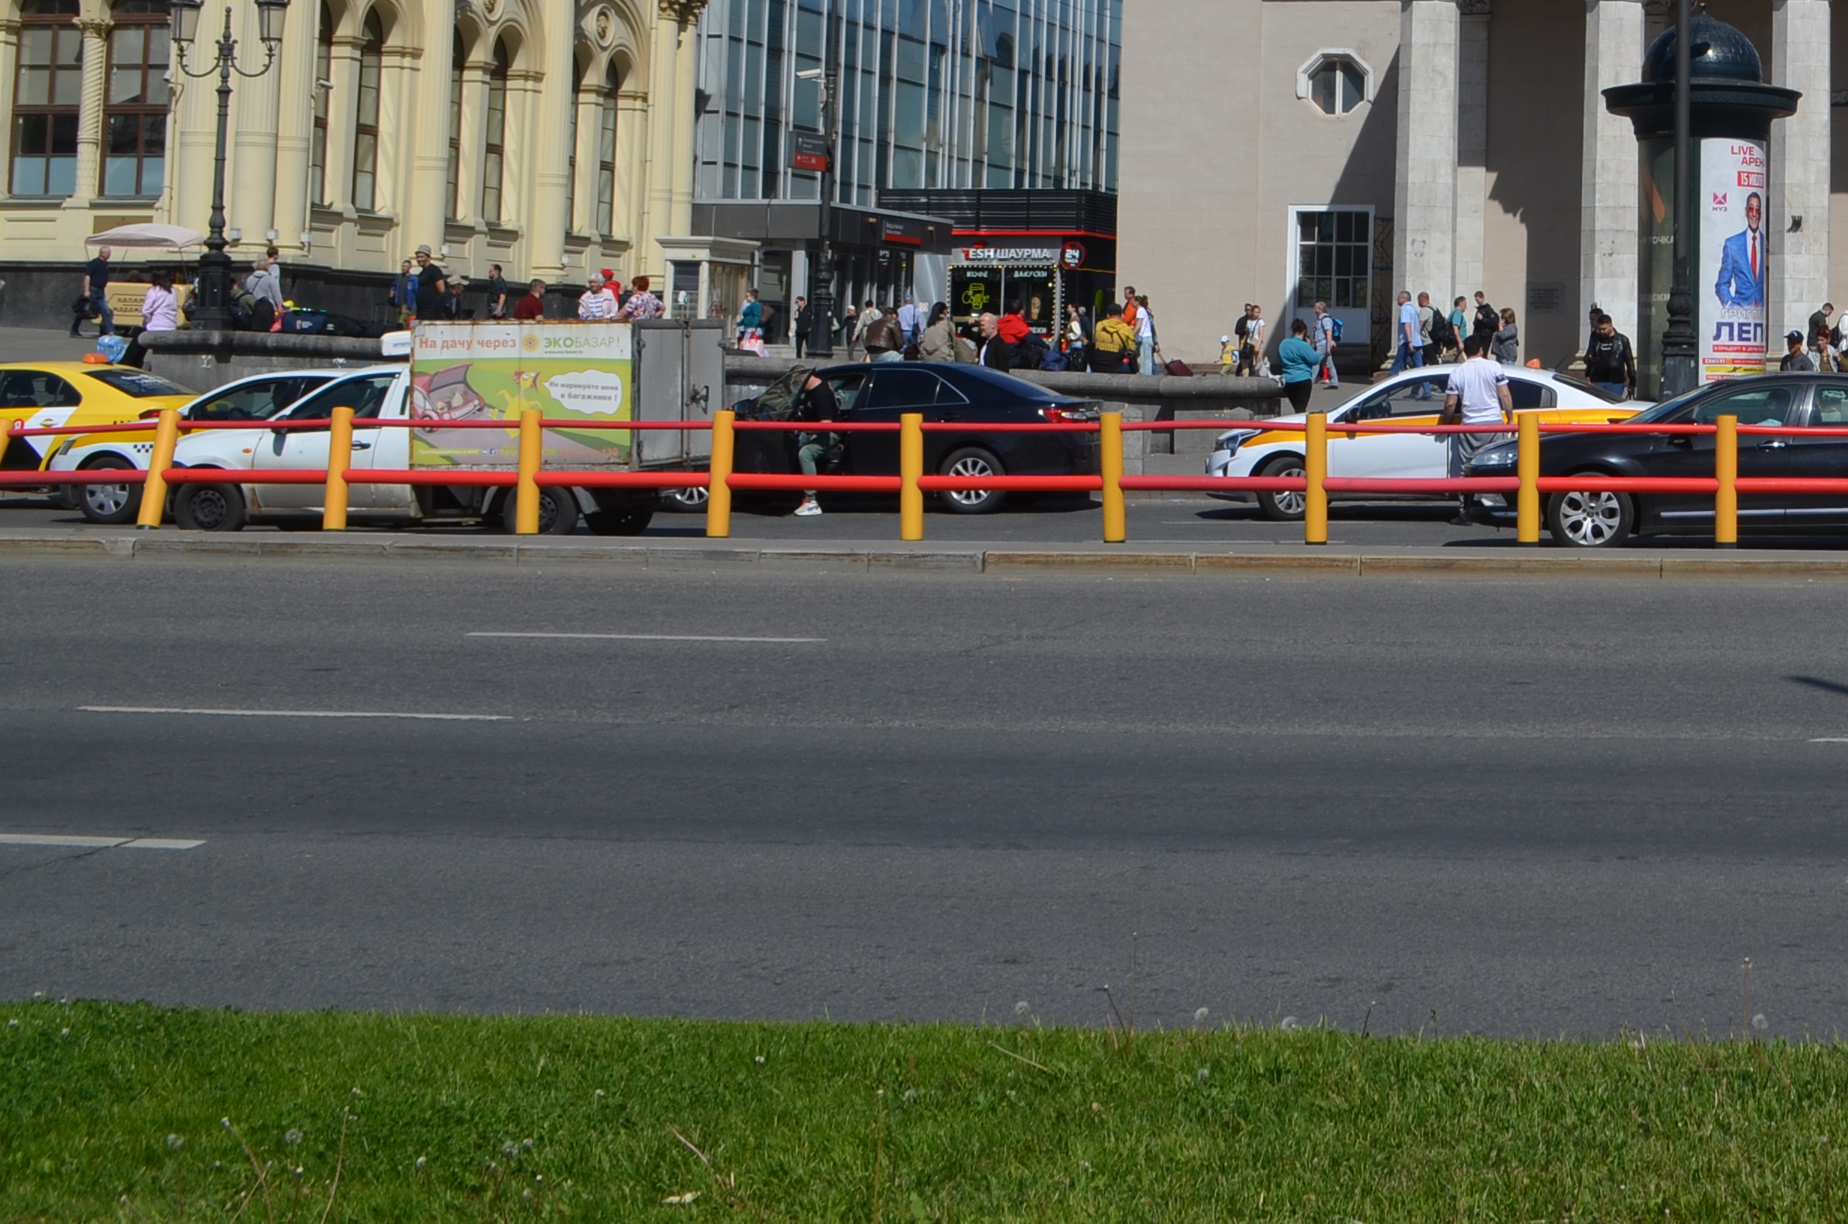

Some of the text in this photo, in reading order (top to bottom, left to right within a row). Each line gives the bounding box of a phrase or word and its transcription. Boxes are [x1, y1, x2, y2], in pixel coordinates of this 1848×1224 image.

[1730, 145, 1755, 156] LIVE
[1740, 172, 1749, 186] 15
[996, 248, 1051, 259] ШАУРМА
[1064, 249, 1080, 259] 24
[419, 337, 437, 349] На
[441, 339, 473, 351] дачу
[477, 338, 517, 351] через
[544, 336, 620, 349] ЭКОБАЗАР!
